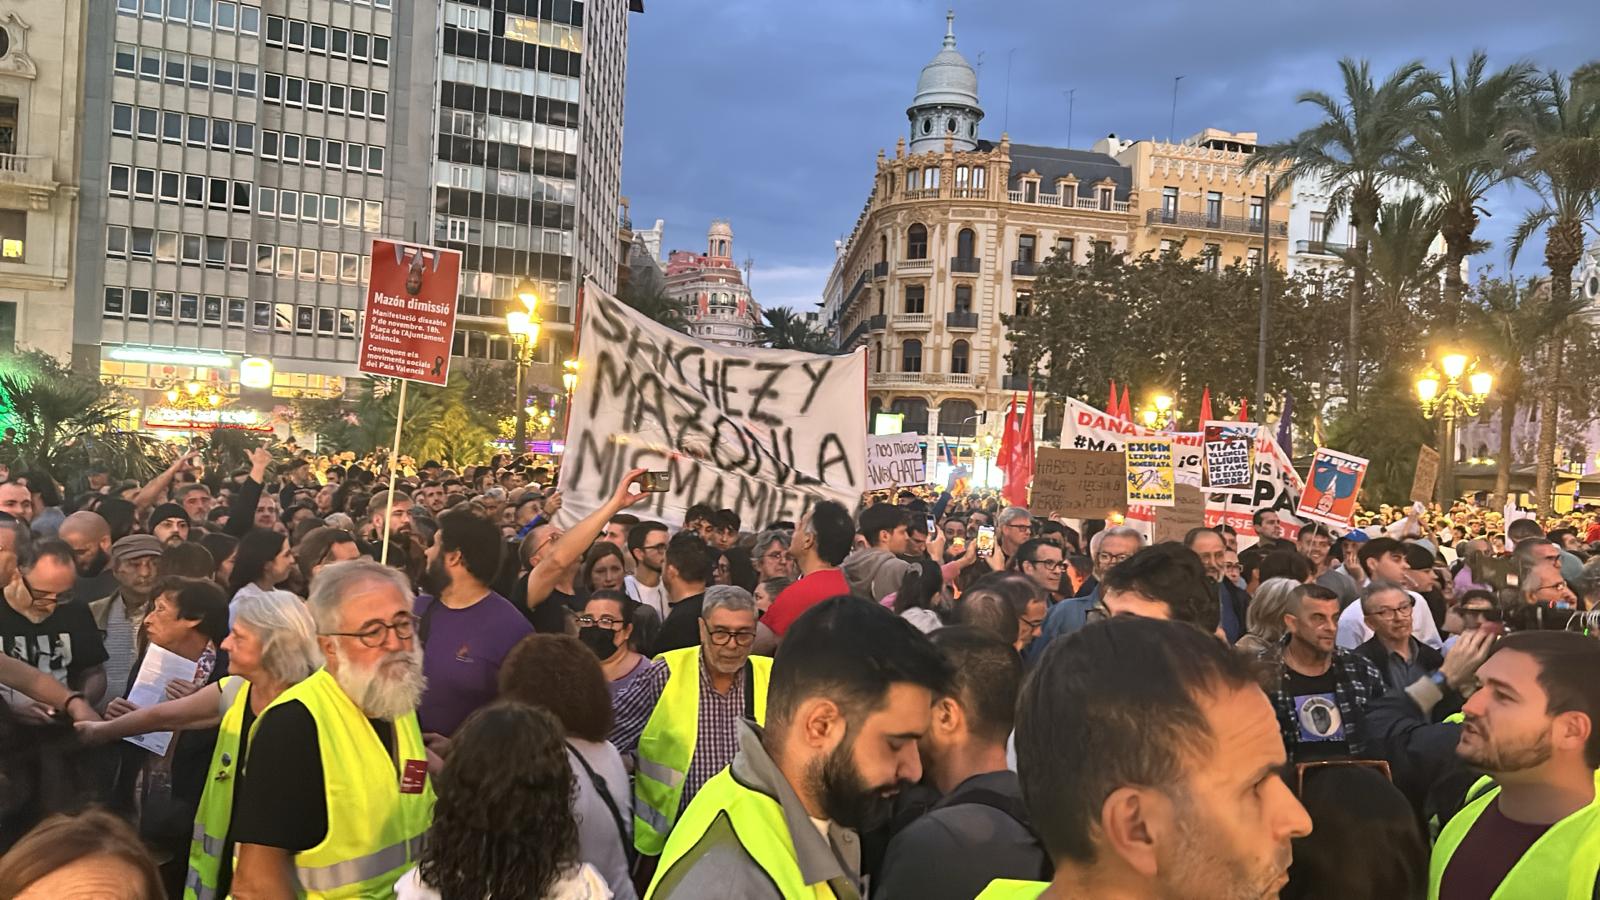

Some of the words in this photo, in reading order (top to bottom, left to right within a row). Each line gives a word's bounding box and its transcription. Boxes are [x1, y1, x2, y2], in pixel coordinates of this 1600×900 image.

[374, 292, 405, 308] Mazón
[407, 299, 450, 315] dimissió
[371, 316, 377, 324] 9
[387, 320, 424, 331] novembre.
[426, 326, 440, 334] 18h.
[372, 308, 416, 322] Manifestació
[418, 315, 447, 327] dissabte
[370, 324, 390, 334] Plaça
[368, 344, 406, 356] Convoquen
[407, 351, 419, 359] els
[366, 360, 378, 369] del
[367, 353, 405, 364] moviments
[406, 359, 431, 369] socials
[799, 359, 832, 414] Y
[1078, 412, 1137, 437] DANA
[1208, 442, 1246, 451] VISCA
[1209, 456, 1248, 465] LLIURE
